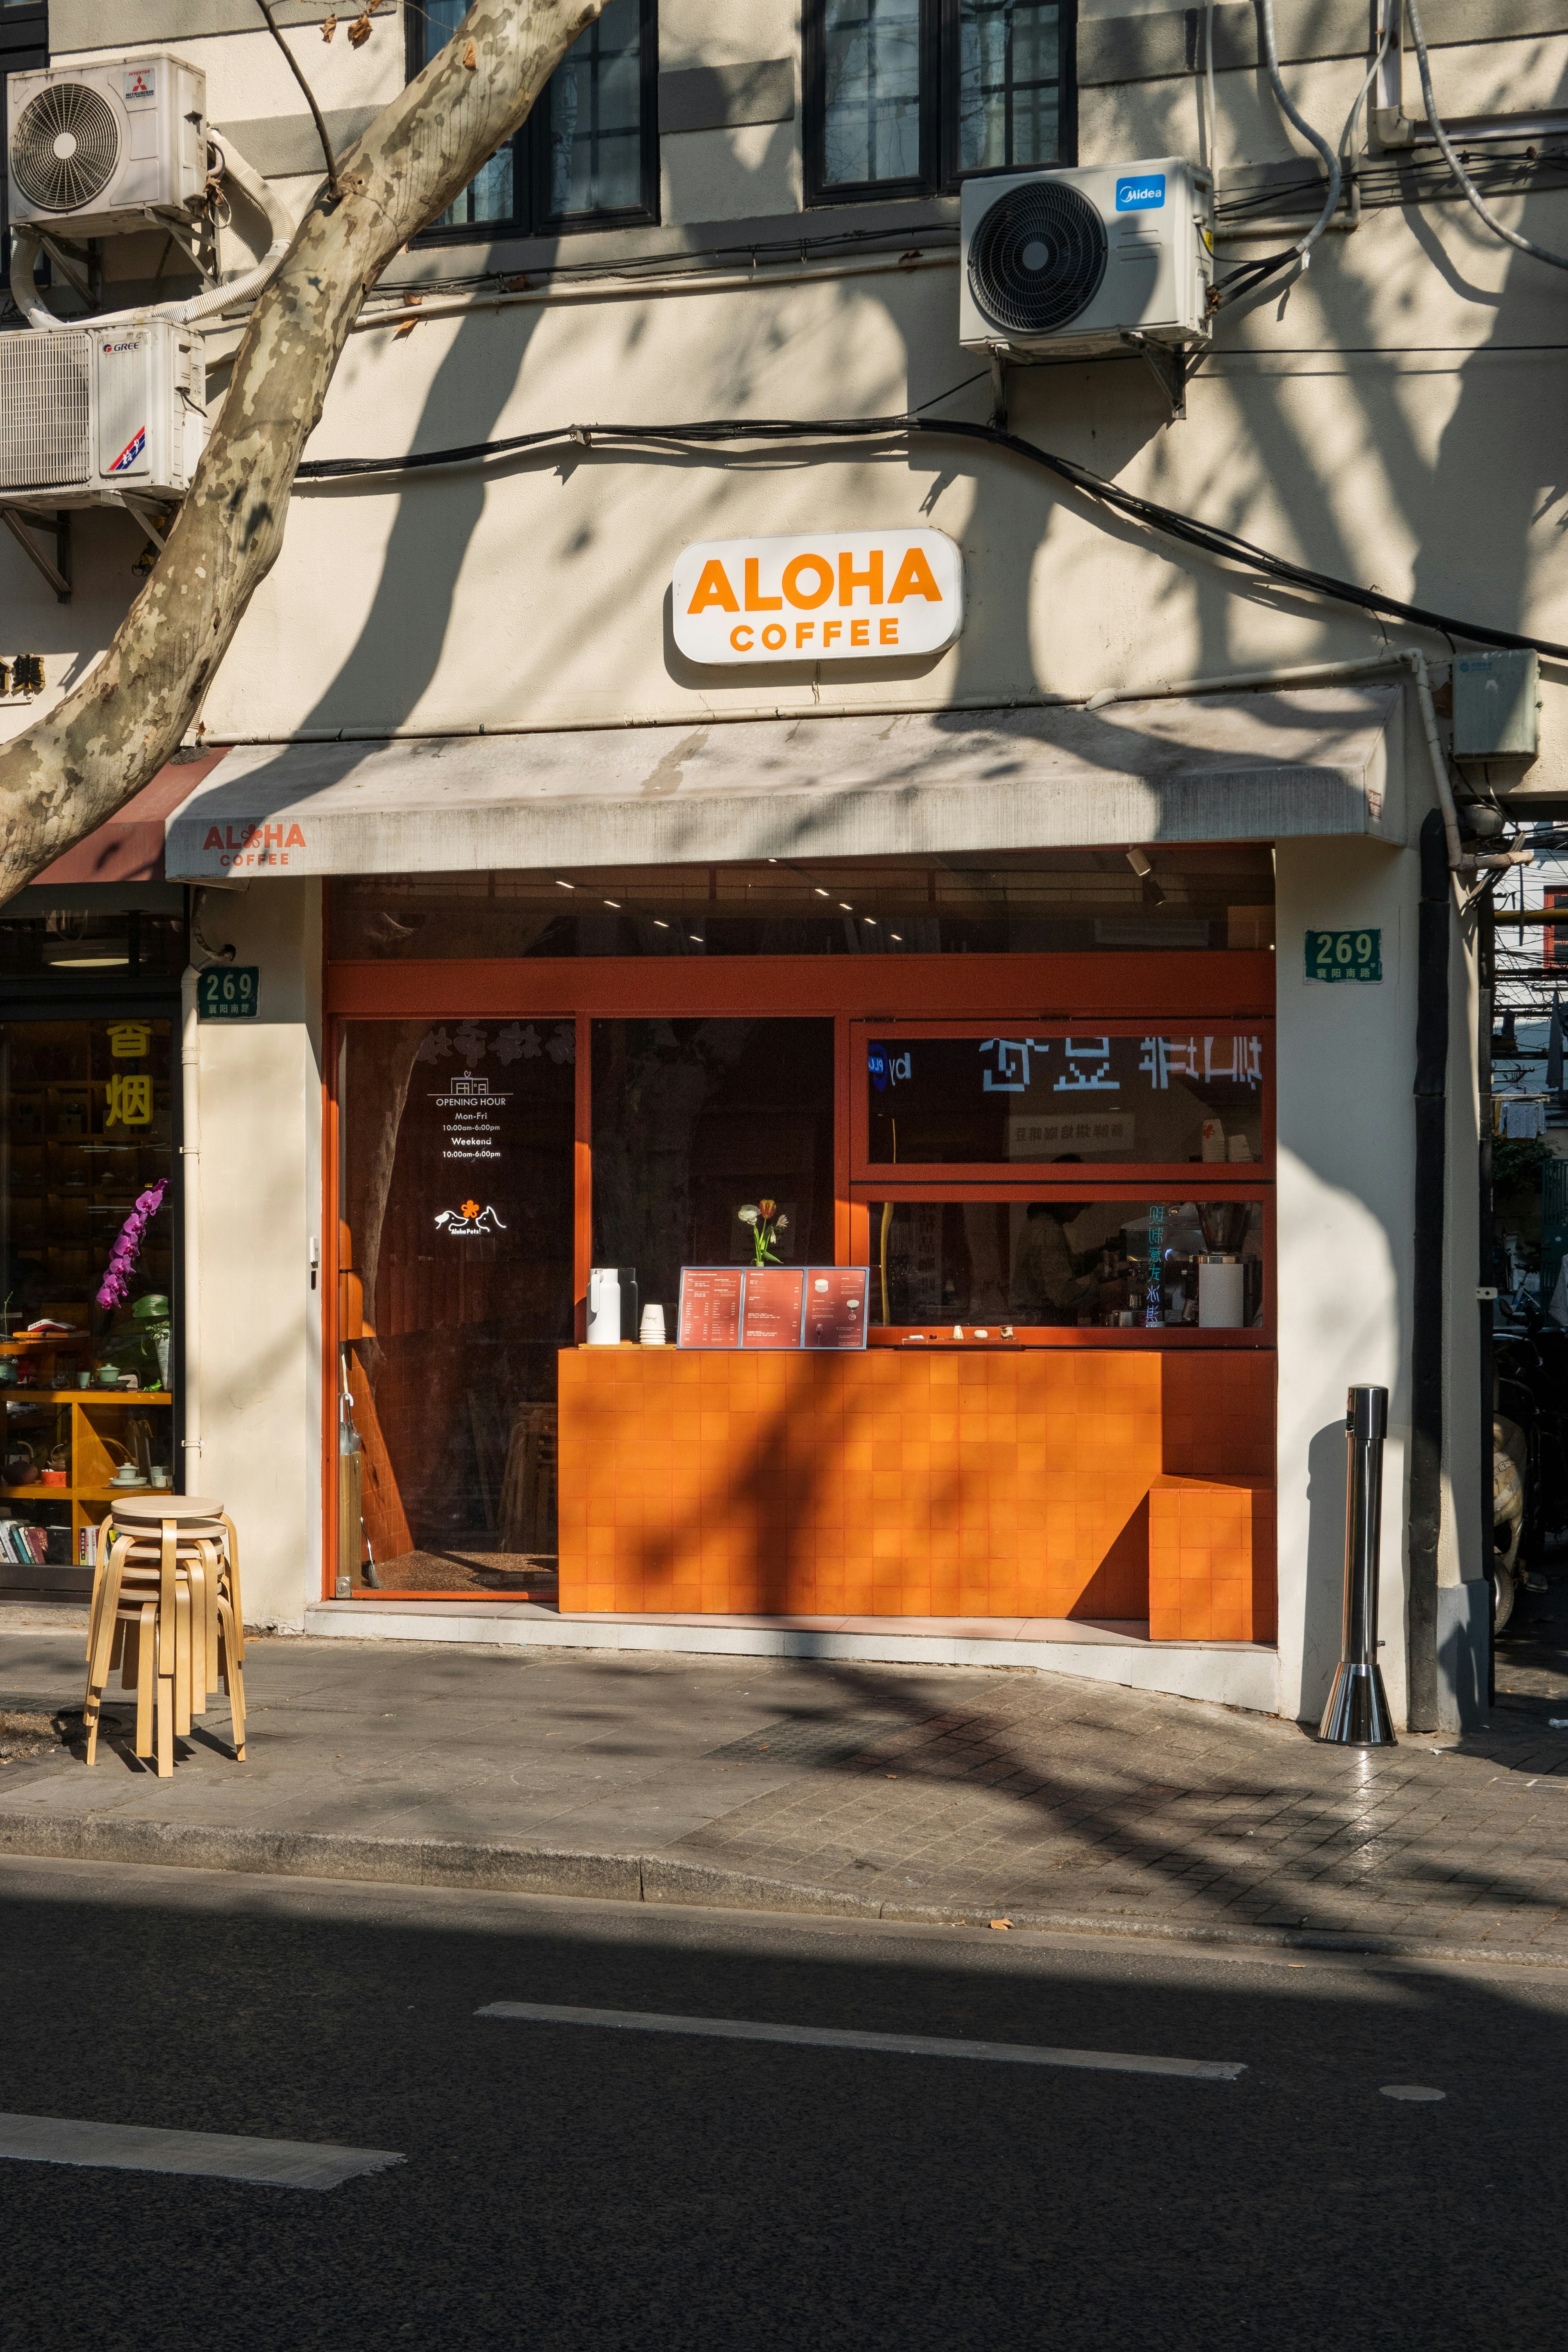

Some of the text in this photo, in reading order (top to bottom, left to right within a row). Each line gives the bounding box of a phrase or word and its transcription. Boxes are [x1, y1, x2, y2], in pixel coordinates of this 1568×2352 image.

[1120, 186, 1162, 202] Midea
[113, 342, 140, 351] GREE
[687, 548, 943, 614] ALOHA
[730, 618, 899, 652] COFFEE
[220, 853, 289, 867] COFFEE
[1317, 934, 1372, 963] 269
[1317, 968, 1371, 978] 襄阳南路
[207, 974, 252, 1000] 269
[208, 1004, 250, 1014] 襄阳南路
[451, 1137, 491, 1145] Weekend
